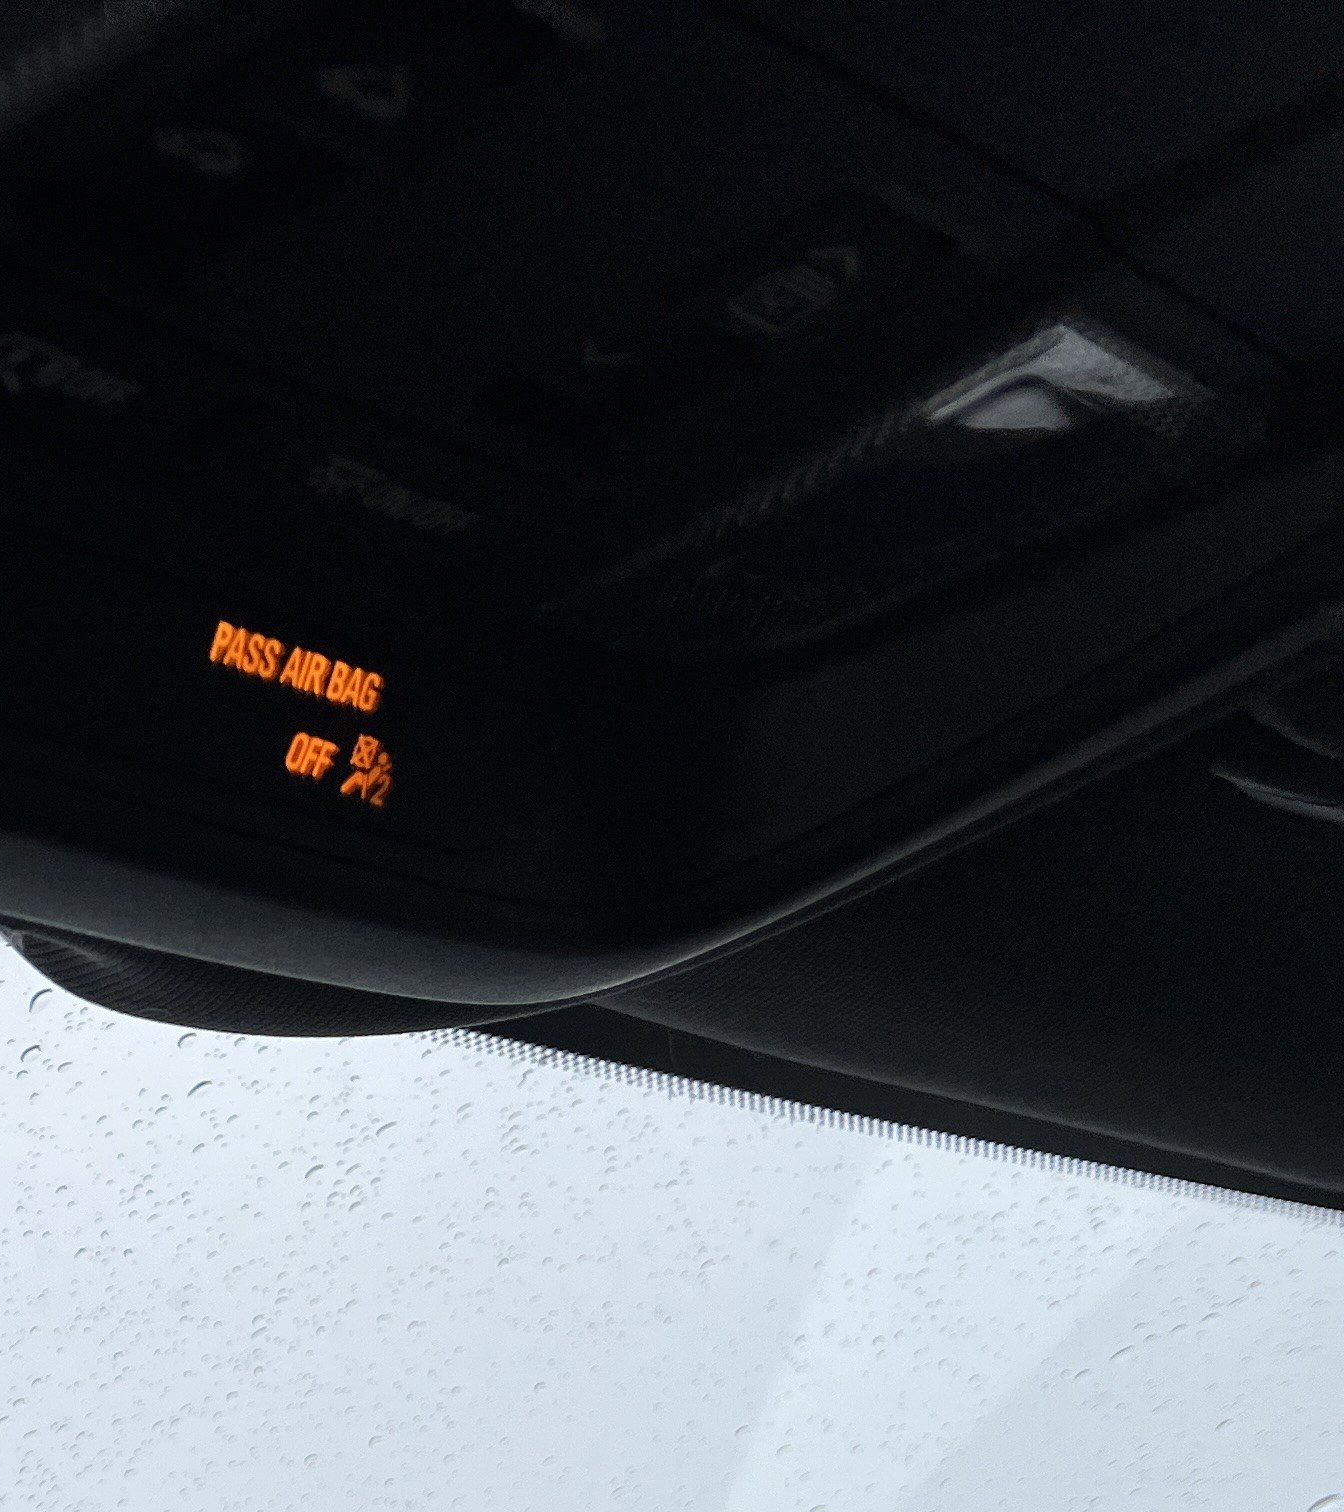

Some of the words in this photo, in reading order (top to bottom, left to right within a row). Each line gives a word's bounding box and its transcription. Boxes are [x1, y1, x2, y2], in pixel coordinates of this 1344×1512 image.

[210, 619, 284, 681] PASS
[279, 646, 331, 697] AIR
[326, 660, 385, 713] BAG
[285, 731, 340, 780] OFF
